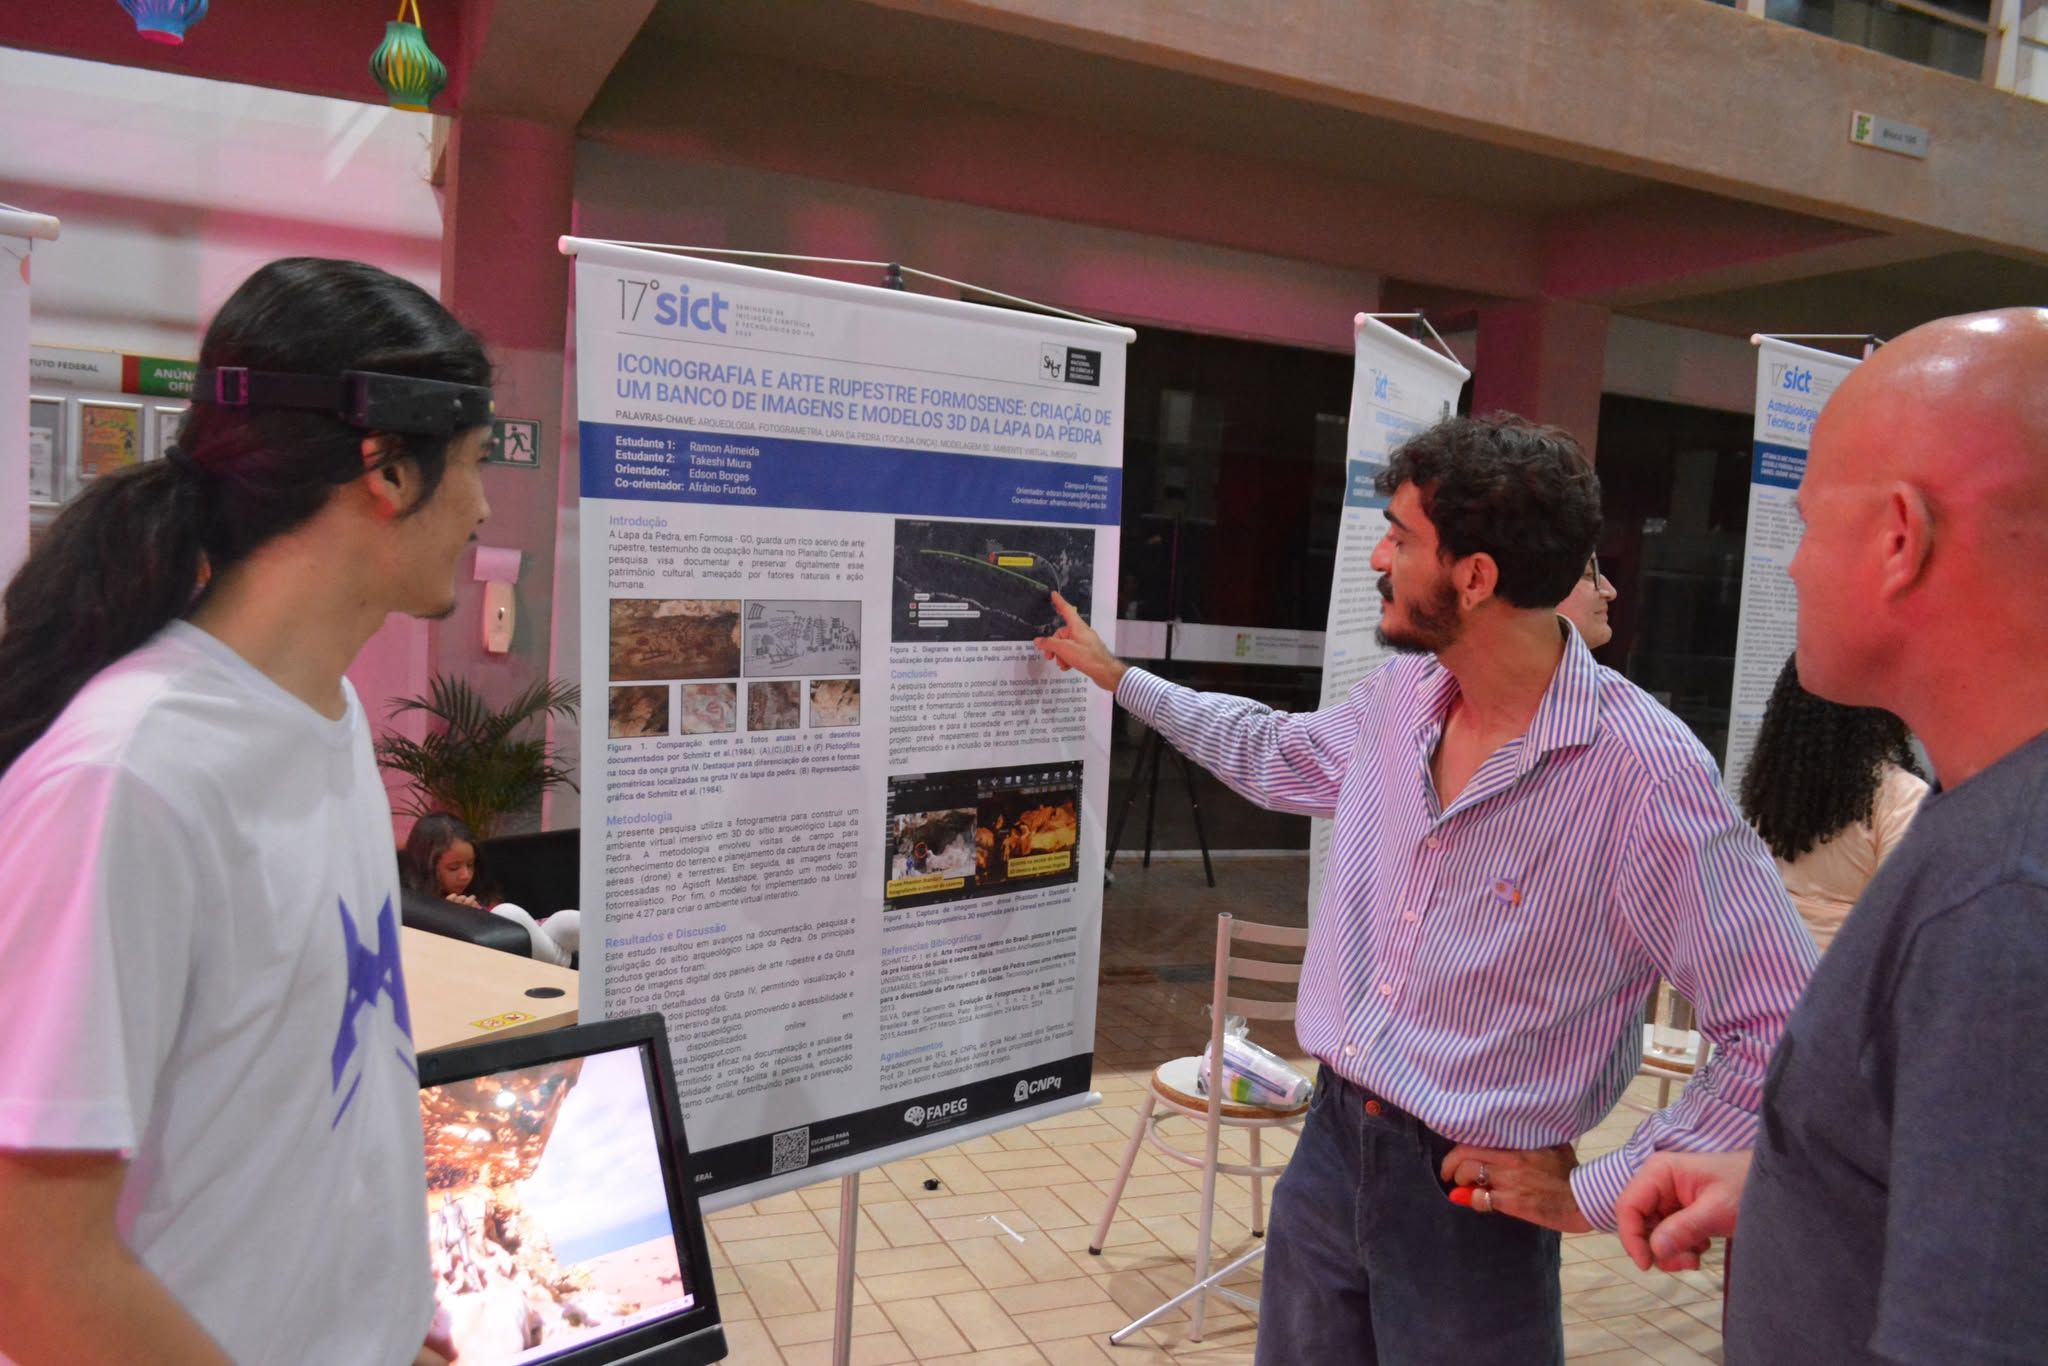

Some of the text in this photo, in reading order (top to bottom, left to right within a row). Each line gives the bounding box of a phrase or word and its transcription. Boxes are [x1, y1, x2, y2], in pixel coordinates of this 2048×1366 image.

[58, 361, 98, 372] FEDERAL
[618, 352, 1111, 426] ICONOGRAFIA E ARTE RUPESTRE FORMOSENSE: CRIAÇÃO DE
[617, 379, 1102, 445] UM BANCO DE IMAGENS E MODELOS 3D DA LAPA DA PEDRA
[616, 410, 696, 425] PALAVRAS-CHAVE:
[826, 429, 844, 438] LAPA
[846, 431, 855, 439] DA
[857, 432, 880, 442] PEDRA
[616, 437, 759, 456] Estudante 1: Ramon Almeida
[616, 451, 751, 468] Estudante 2: Takeshi Miura
[614, 464, 750, 483] Orientador: Edson Borges
[614, 478, 756, 495] Co-orientador: Afrânio Furtado
[609, 516, 668, 529] Introdução
[609, 530, 615, 539] A
[618, 530, 640, 542] Lapa
[642, 531, 653, 540] da
[655, 531, 682, 542] Pedra,
[699, 533, 733, 543] Formosa
[756, 535, 782, 546] guarda
[798, 536, 813, 545] rico
[839, 538, 849, 547] de
[851, 539, 864, 547] arte
[609, 544, 646, 554] rupestre,
[649, 545, 698, 554] testemunho
[701, 545, 710, 554] da
[713, 546, 750, 557] ocupação
[753, 547, 783, 556] humana
[798, 548, 827, 557] Planalto
[829, 549, 856, 558] Central.
[859, 549, 864, 558] A
[608, 556, 648, 567] pesquisa
[657, 557, 674, 565] visa
[683, 557, 729, 566] documentar
[751, 560, 786, 569] preservar
[795, 559, 840, 570] digitalmente
[608, 568, 655, 579] patrimônio
[662, 569, 695, 579] cultural,
[702, 570, 742, 580] ameaçado
[748, 572, 760, 581] por
[767, 570, 794, 579] fatores
[800, 571, 830, 580] naturais
[846, 571, 863, 582] ação
[890, 669, 938, 679] Conclusões
[605, 813, 672, 826] Metodologia
[606, 829, 612, 838] A
[617, 826, 654, 840] presente
[659, 822, 696, 836] pesquisa
[700, 820, 723, 829] utiliza
[736, 813, 787, 827] fotogrametria
[790, 813, 807, 823] para
[811, 808, 843, 819] construir
[605, 830, 858, 863] Pedra. A metodologia envolveu visitas de campo para
[604, 923, 728, 947] Resultados e Discussão
[605, 951, 623, 960] Este
[627, 946, 656, 957] estudo
[660, 941, 693, 953] resultou
[696, 939, 709, 948] em
[712, 933, 742, 945] avanços
[746, 931, 755, 940] na
[816, 917, 848, 931] pesquisa
[850, 916, 855, 924] e
[881, 933, 983, 956] Referências Bibliográficas
[1029, 1076, 1061, 1094] CNPq
[927, 1098, 968, 1120] FAPEG
[696, 1172, 712, 1182] ERAL
